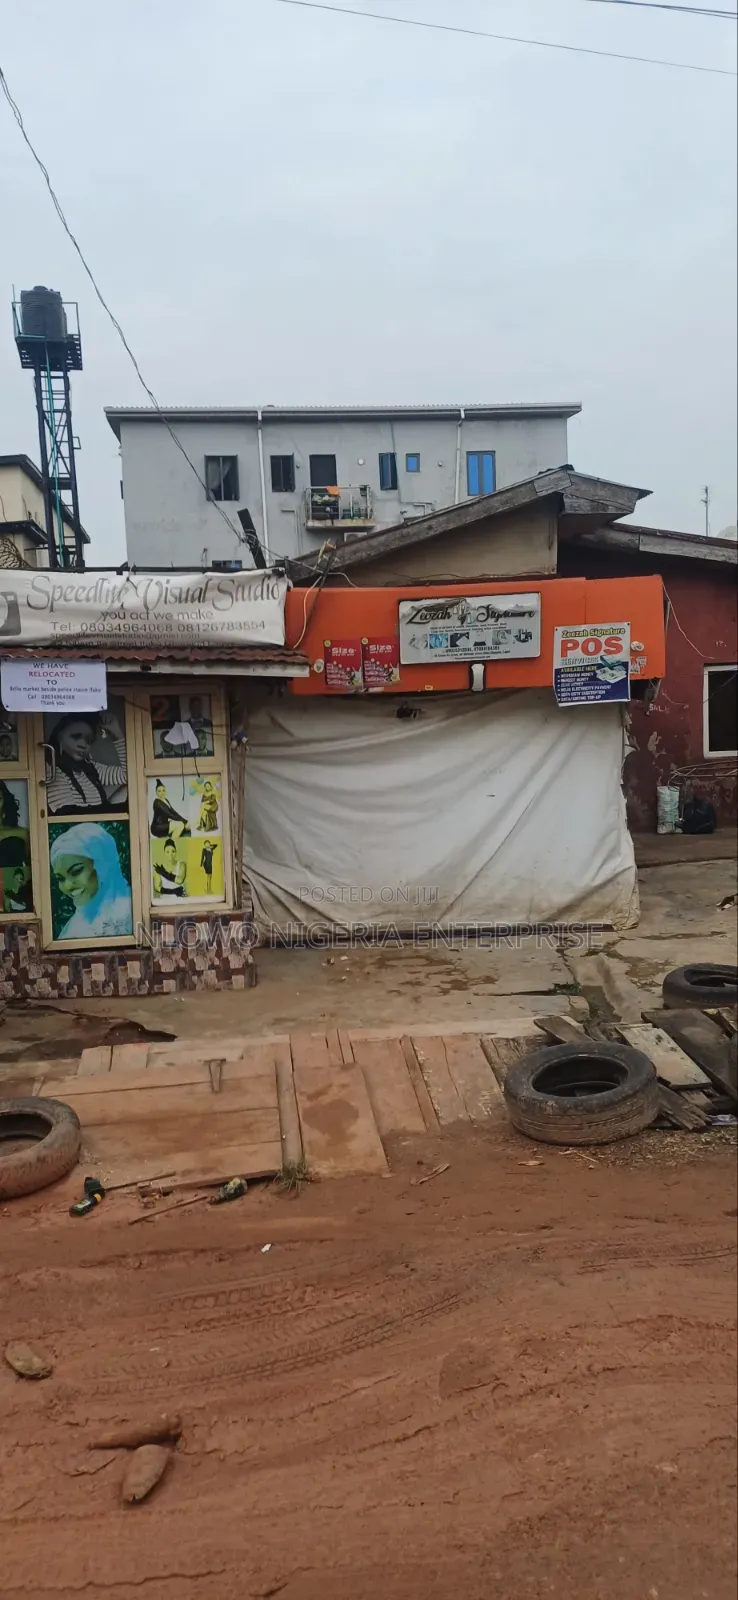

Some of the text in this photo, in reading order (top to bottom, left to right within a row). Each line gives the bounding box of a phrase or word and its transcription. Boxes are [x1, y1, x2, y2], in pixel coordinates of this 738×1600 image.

[136, 578, 211, 612] Visual
[100, 609, 214, 621] you act we make
[50, 621, 75, 632] Tel:
[80, 622, 173, 633] 08034964068
[561, 627, 626, 639] Zeezah Signature
[560, 635, 624, 658] POS
